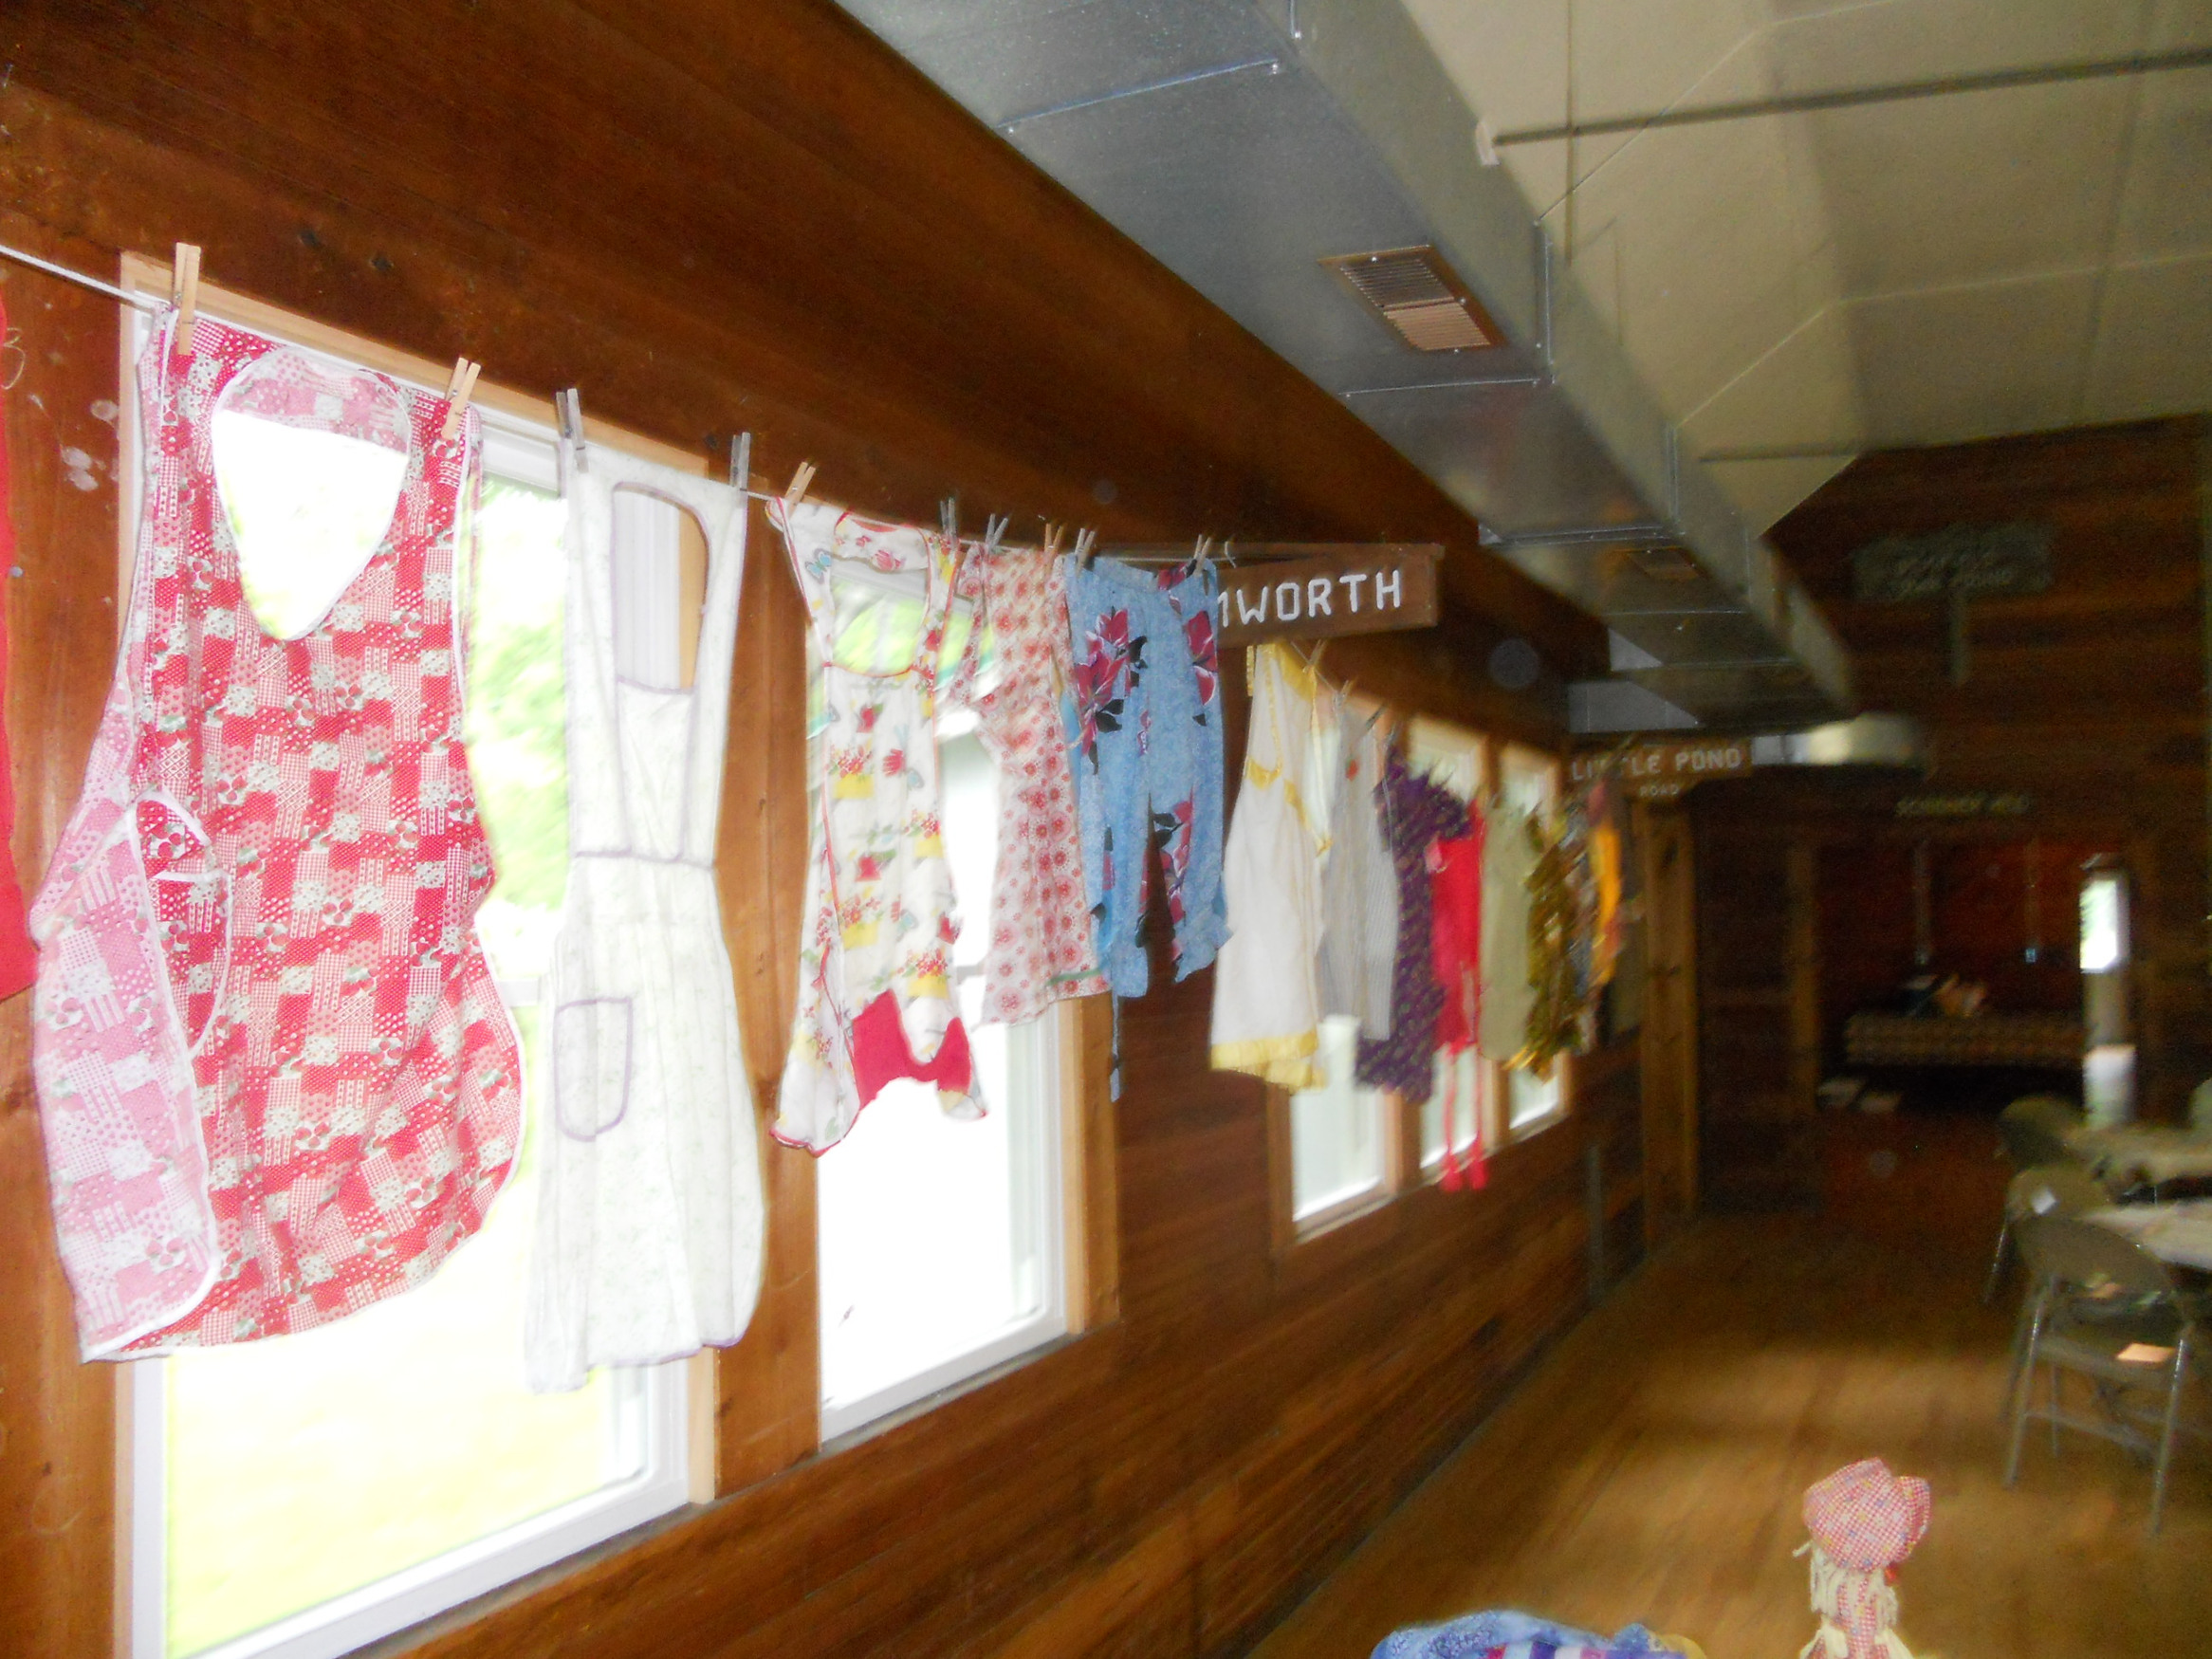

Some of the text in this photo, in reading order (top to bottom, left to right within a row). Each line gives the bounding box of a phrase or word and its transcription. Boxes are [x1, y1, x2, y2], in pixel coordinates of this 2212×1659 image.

[1572, 747, 1741, 781] LILE POND
[1639, 783, 1680, 798] ROAD
